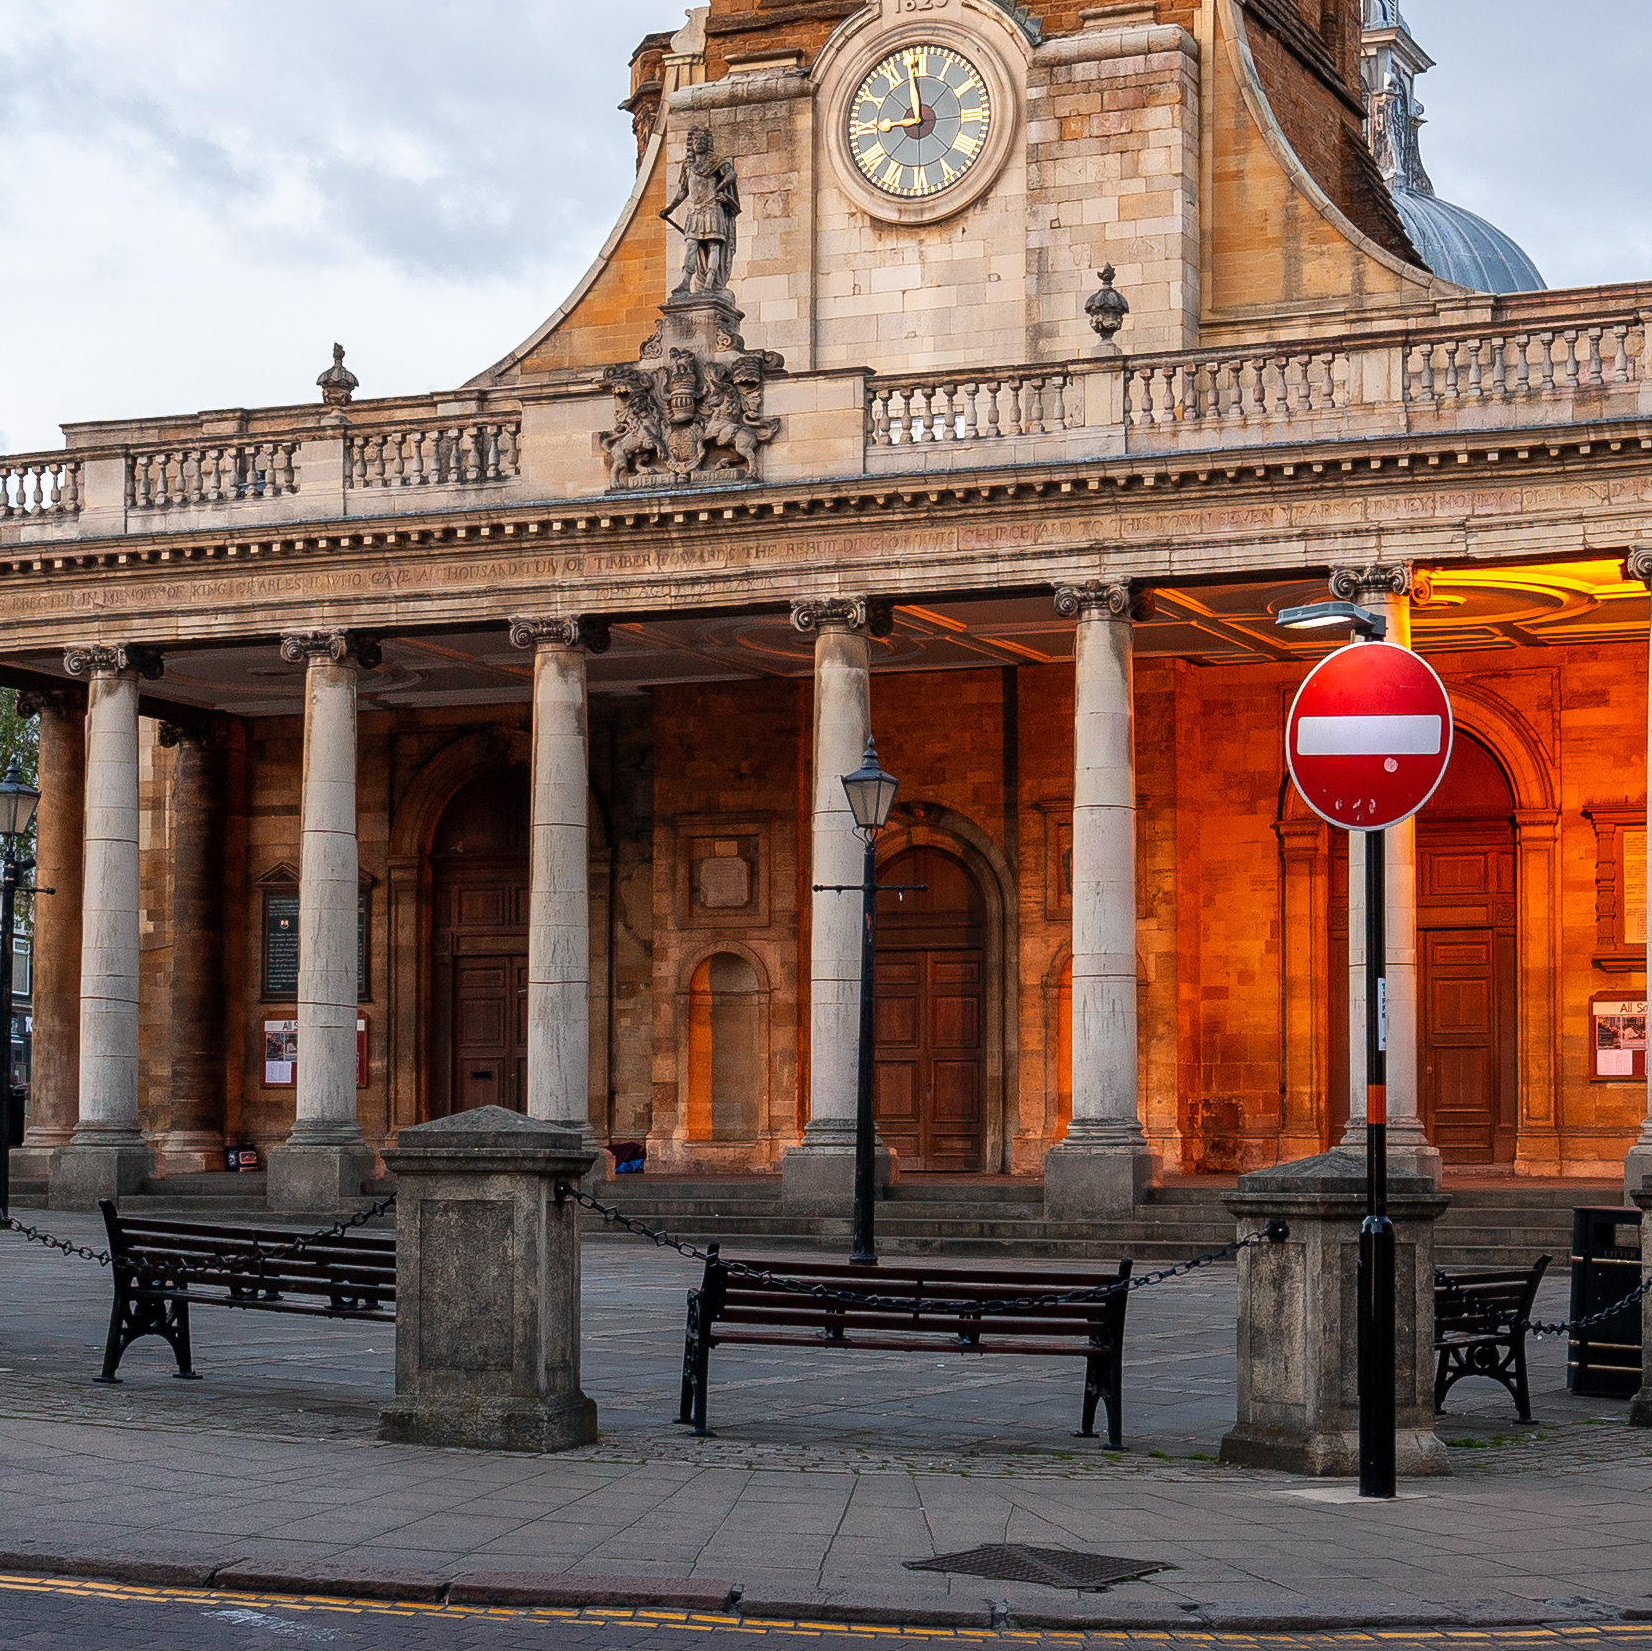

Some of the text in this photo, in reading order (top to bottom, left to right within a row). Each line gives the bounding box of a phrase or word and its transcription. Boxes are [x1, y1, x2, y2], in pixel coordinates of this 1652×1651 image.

[961, 107, 983, 124] III
[81, 591, 98, 606] IN
[192, 582, 227, 597] KING
[235, 575, 302, 597] CHARLES
[325, 571, 362, 589] WHO
[371, 569, 412, 586] GAVE
[416, 567, 431, 582] A
[594, 552, 652, 570] TIMBER
[741, 545, 778, 560] THE
[1039, 520, 1072, 538] AND
[1219, 507, 1275, 527] SEVEN
[1279, 501, 1342, 522] YEARS
[1620, 1002, 1633, 1014] All
[282, 1021, 293, 1031] All
[1604, 1250, 1636, 1258] LITTER
